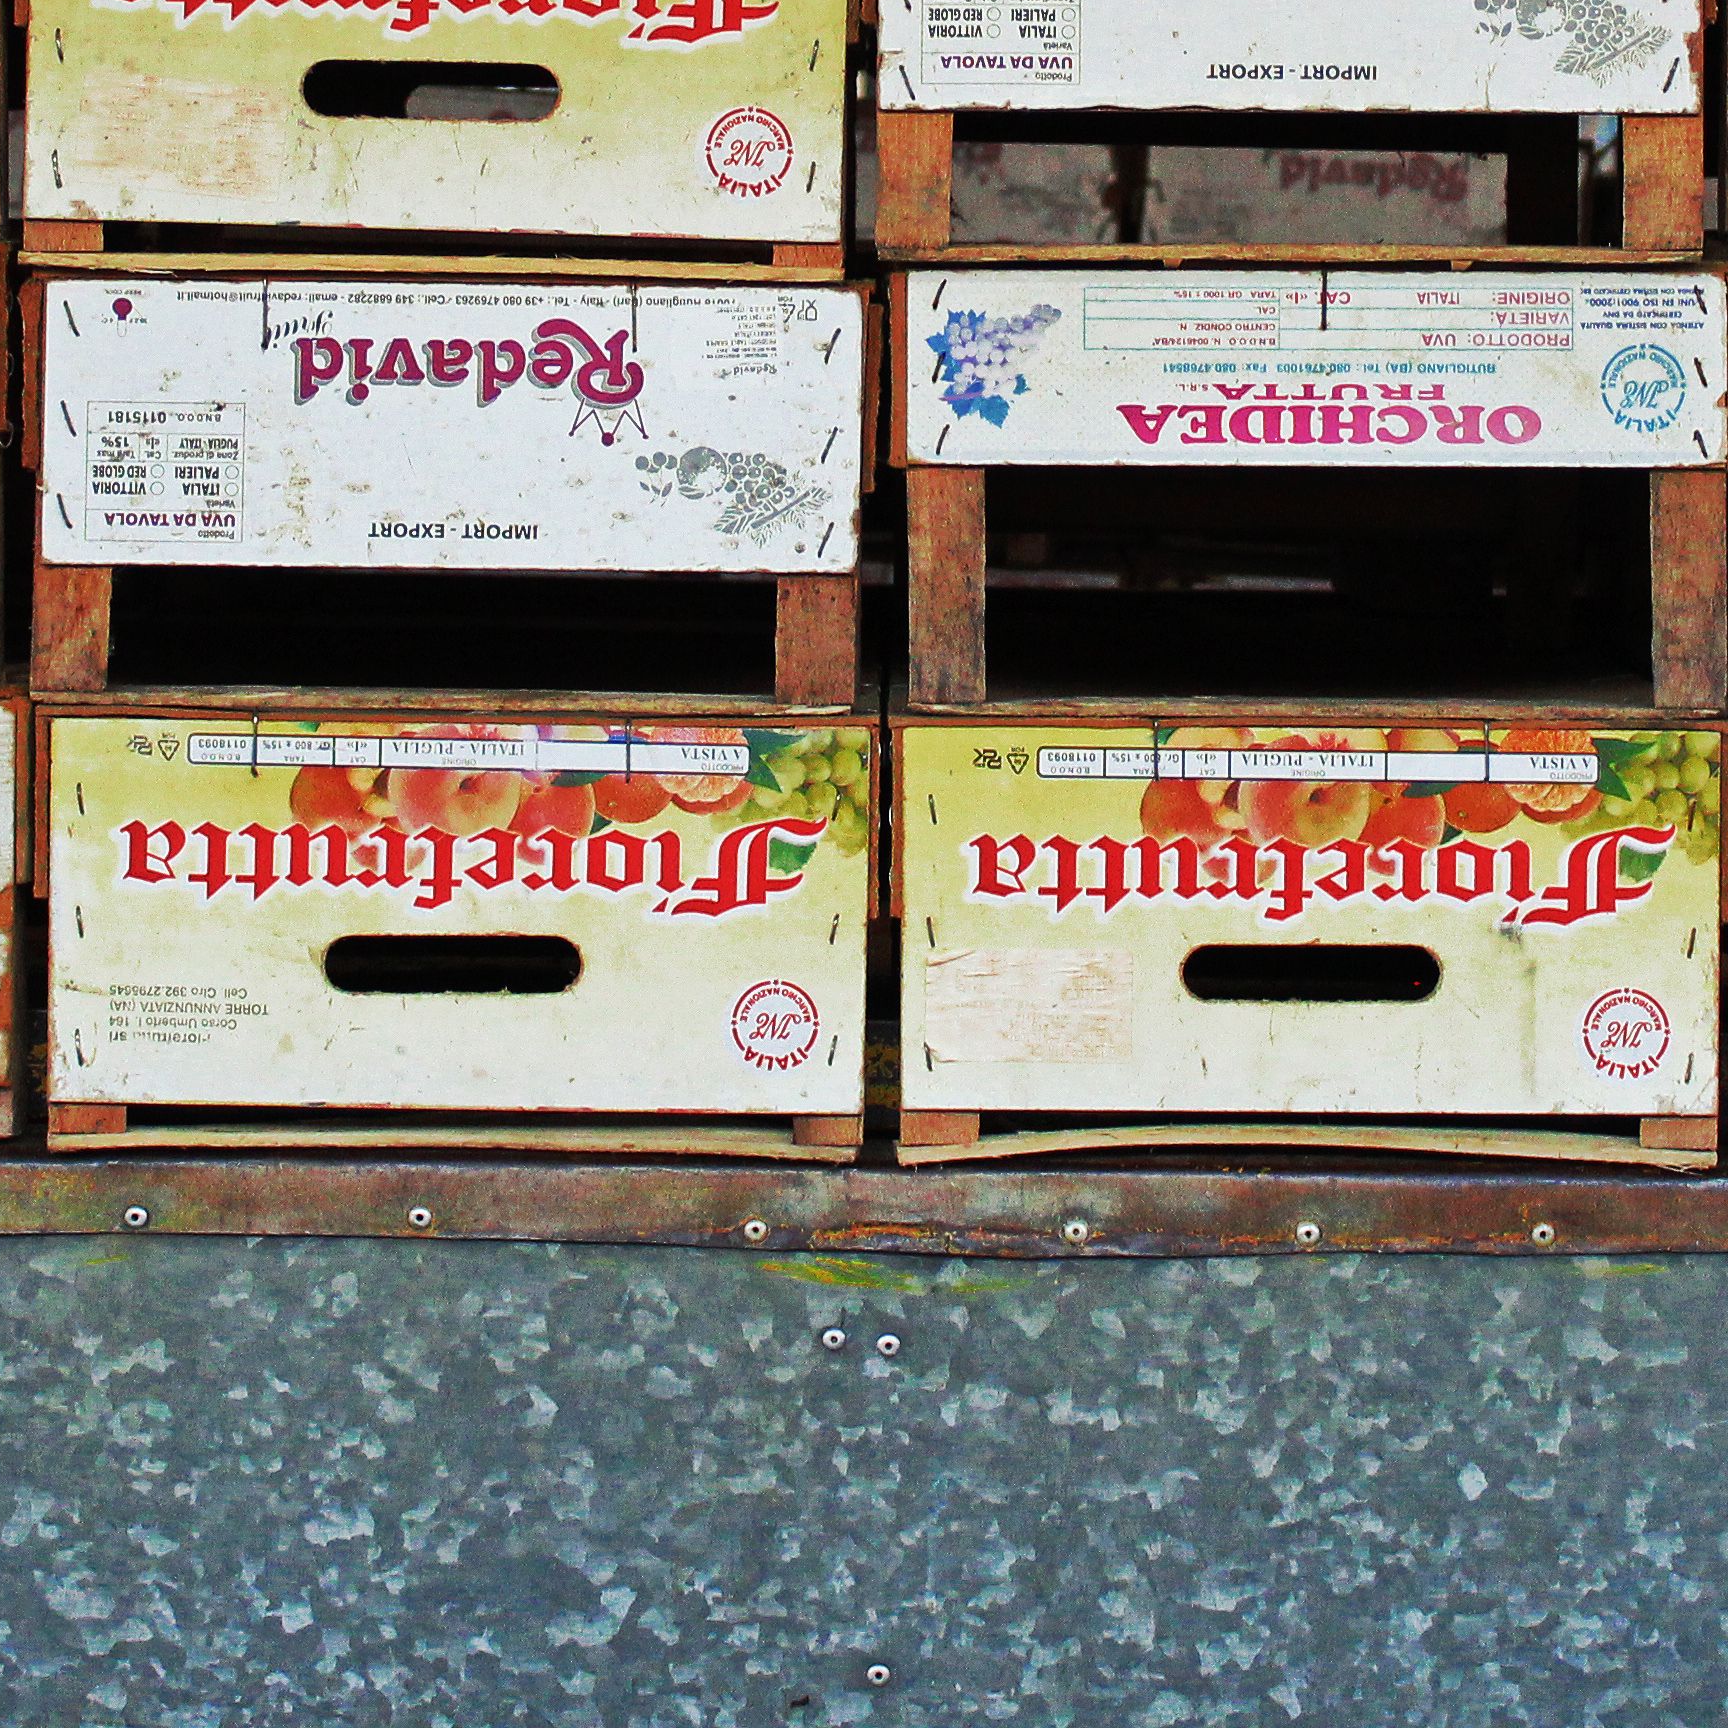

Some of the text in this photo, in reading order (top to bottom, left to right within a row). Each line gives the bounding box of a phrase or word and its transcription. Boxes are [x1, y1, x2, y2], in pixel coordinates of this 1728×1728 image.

[928, 8, 1055, 21] PALIERI RED GLOBE
[928, 25, 1056, 37] ITALIA VITTORIA
[941, 56, 1072, 69] UVA DA TAVOLA
[1035, 73, 1072, 82] Prodotto
[1206, 63, 1377, 81] IMPORT EXPORT
[716, 172, 781, 198] ITALIA
[1417, 291, 1570, 304] ORIGINE: ITALIA
[1421, 333, 1569, 346] PRODOTTO: UVA
[291, 319, 643, 408] Redavid
[1419, 363, 1496, 374] RUTIGLIANO
[1175, 383, 1445, 401] FRUTTA S.R.L.
[108, 411, 166, 424] 0115181
[1116, 403, 1542, 444] ORCHIDEA
[104, 513, 235, 527] UVA DA TAVOLA
[368, 521, 539, 540] IMPORT EXPORT
[198, 738, 246, 749] 0118093
[391, 740, 454, 755] PUGLIA
[1046, 751, 1096, 763] 0118093
[1241, 752, 1374, 767] ITALIA PUGLIA
[120, 818, 826, 917] Fiorefrutta
[967, 824, 1675, 927] Fiorefrutta
[140, 1001, 268, 1015] TORRE ANNUNZIATA
[146, 1018, 197, 1028] Umberto
[202, 1019, 237, 1030] Corso
[744, 1046, 808, 1071] ITALIA
[1596, 1053, 1657, 1079] ITALIA
